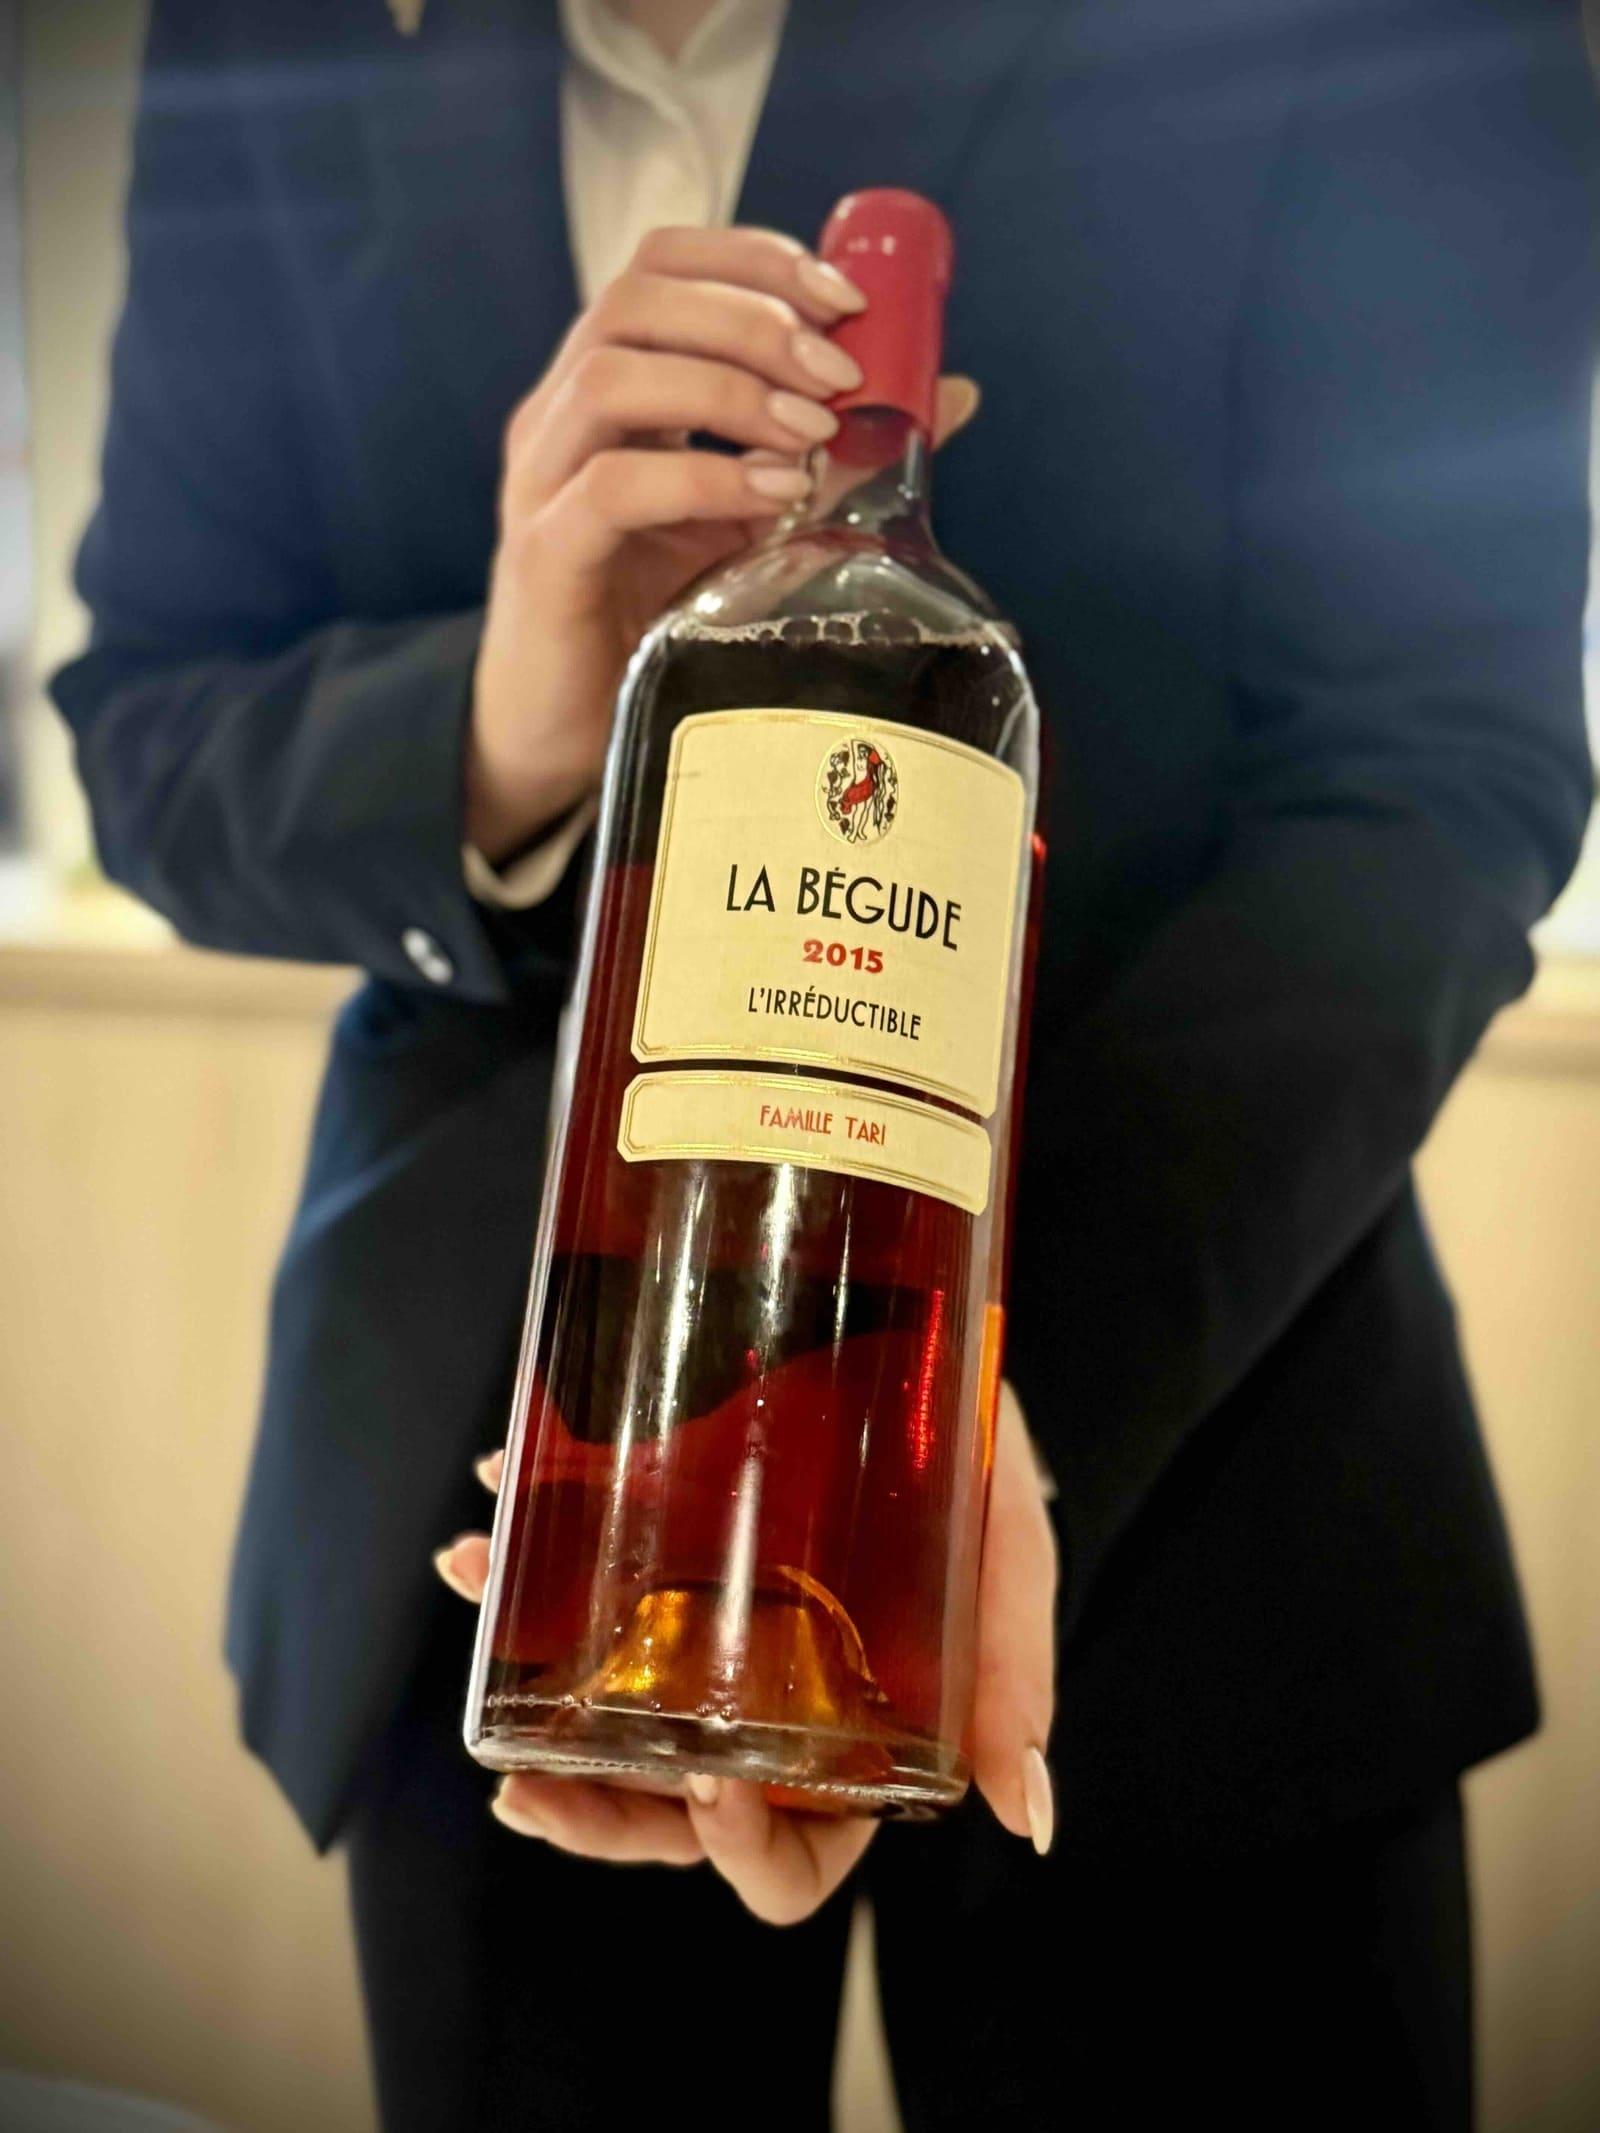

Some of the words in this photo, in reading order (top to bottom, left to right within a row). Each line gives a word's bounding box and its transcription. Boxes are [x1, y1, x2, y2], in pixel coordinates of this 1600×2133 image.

[726, 864, 776, 913] LA
[797, 867, 962, 950] BÉGUDE
[802, 939, 884, 974] 2015
[748, 985, 922, 1041] L'IRRÉDUCTIBLE
[760, 1104, 833, 1136] FAMILLE
[846, 1116, 886, 1146] TARI
